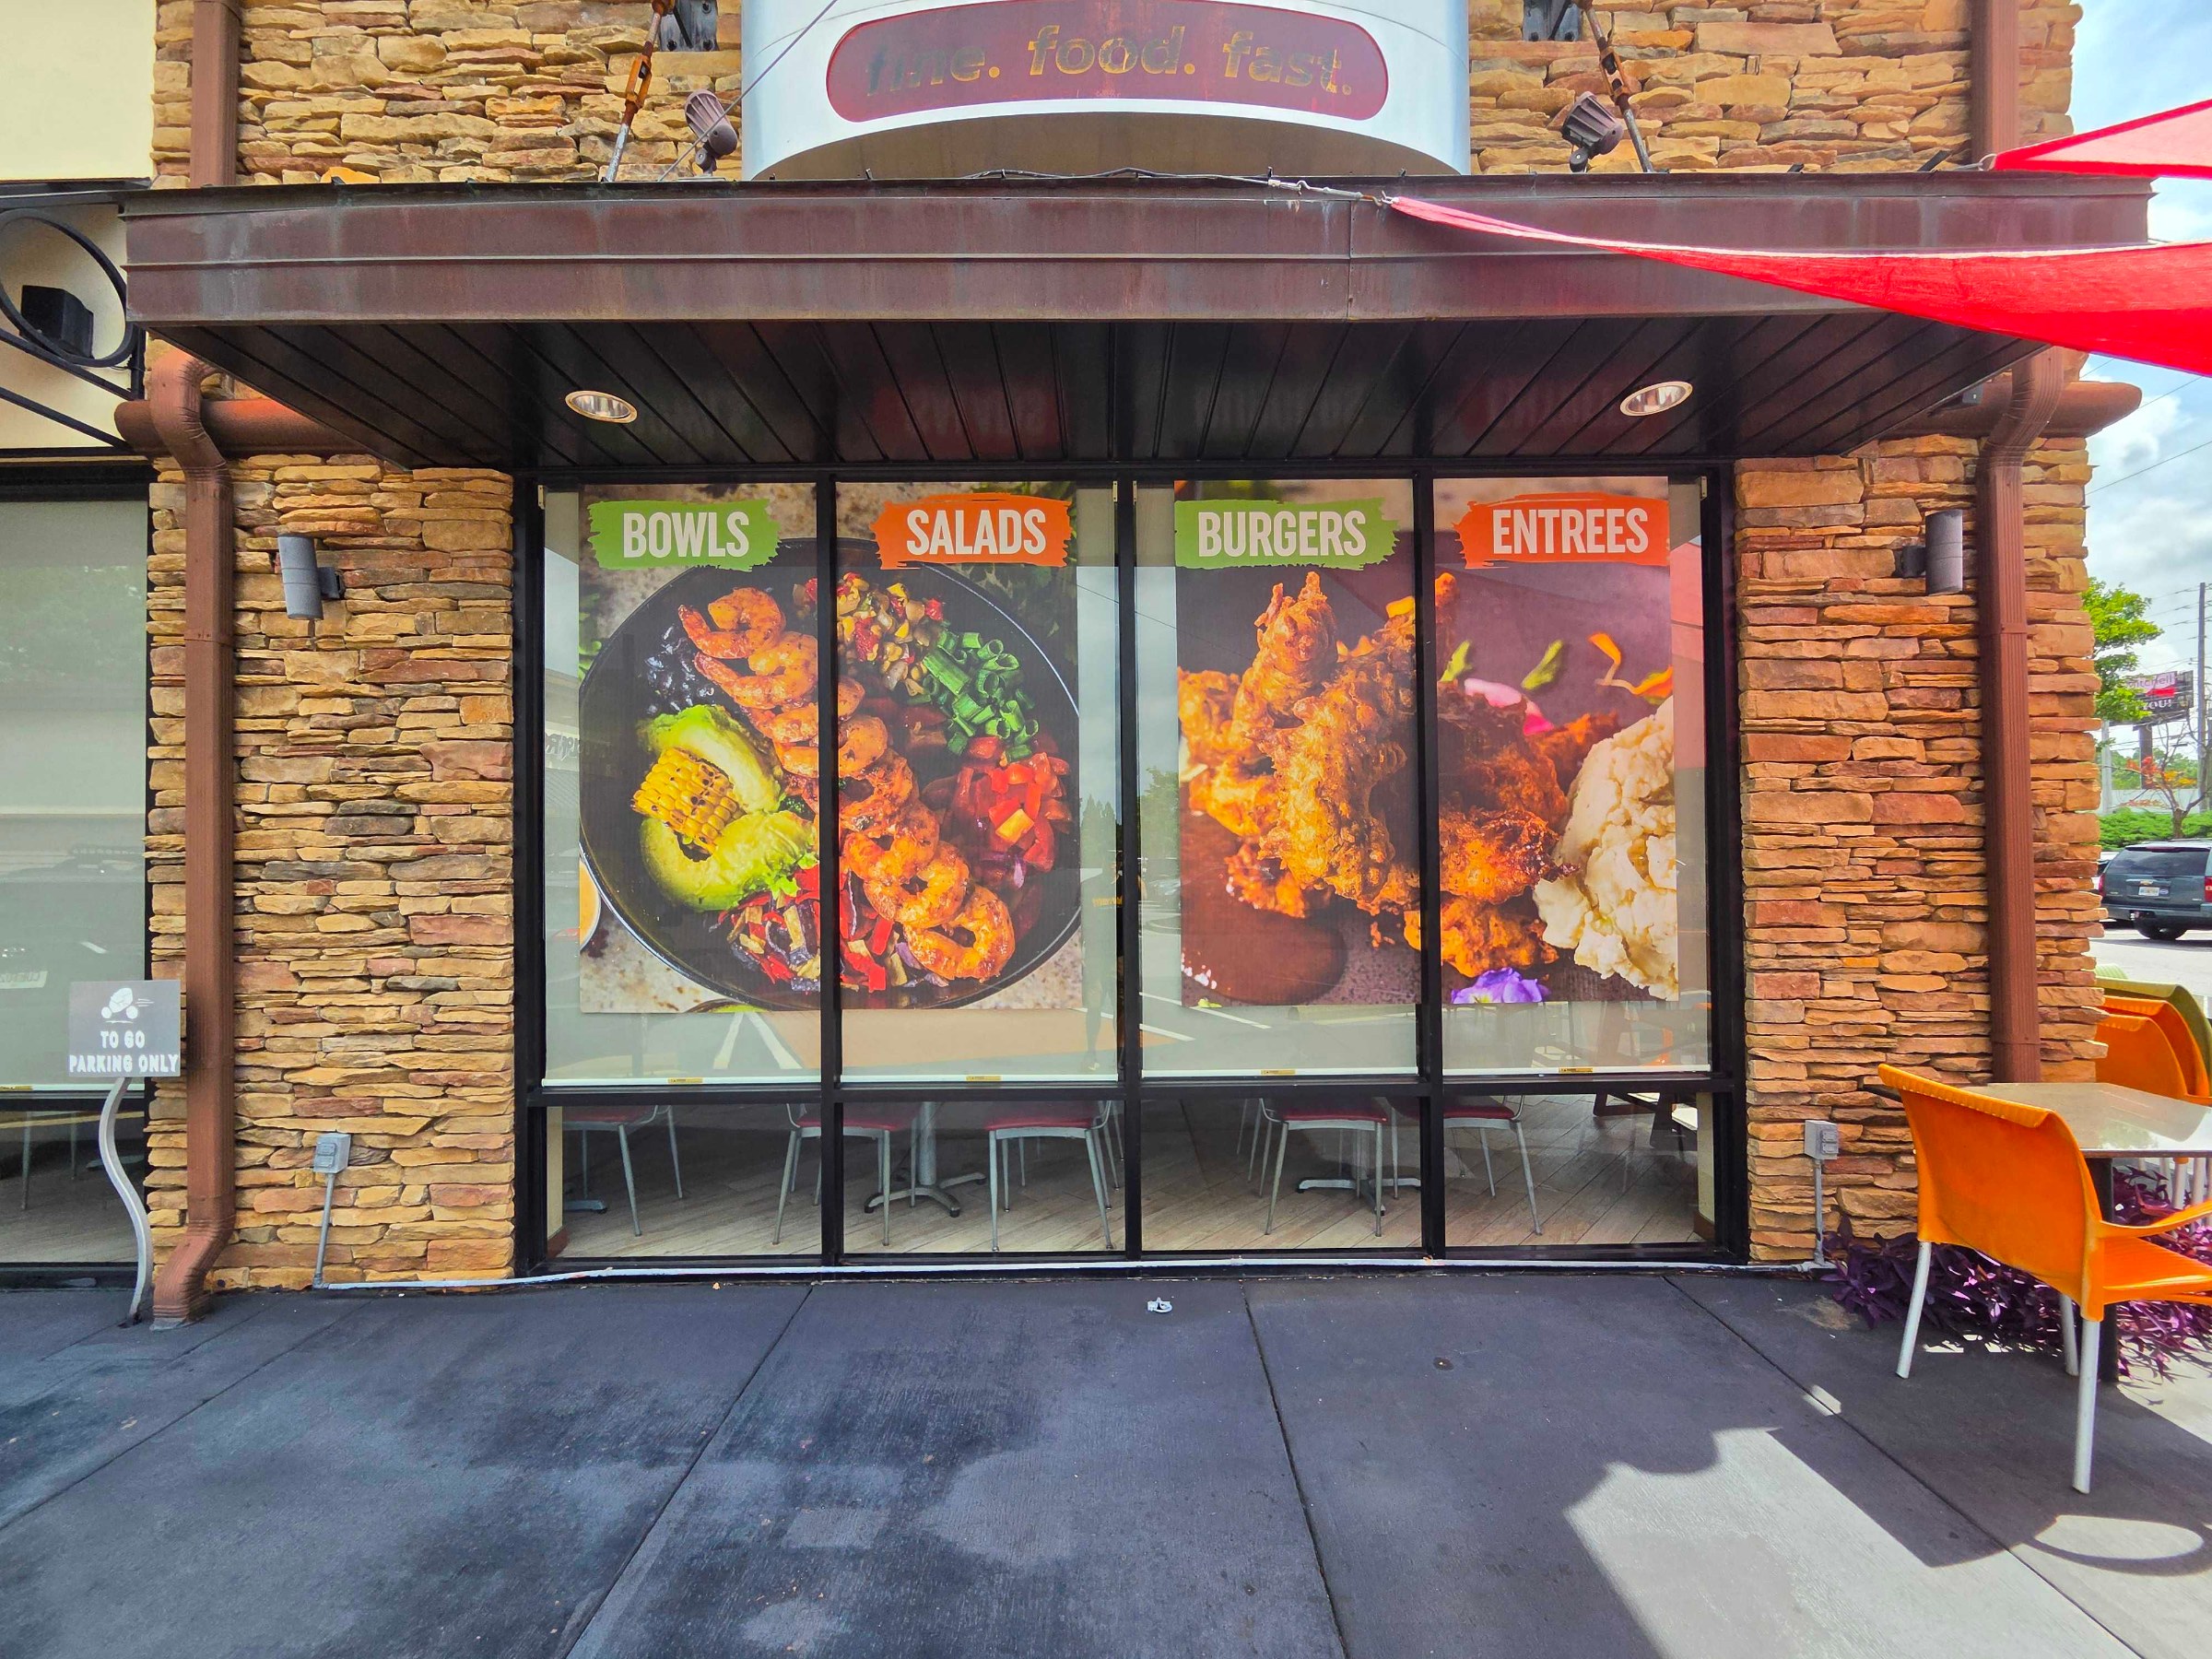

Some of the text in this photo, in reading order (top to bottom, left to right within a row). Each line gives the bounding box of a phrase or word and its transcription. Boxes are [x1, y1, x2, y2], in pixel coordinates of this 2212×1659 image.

[1028, 25, 1195, 75] food.
[1222, 30, 1352, 95] fast.
[623, 512, 749, 558] BOWLS
[906, 509, 1046, 555] SALADS
[1198, 510, 1367, 557] BURGERS
[1492, 508, 1648, 554] ENTREES
[100, 1030, 146, 1049] TO GO
[69, 1053, 178, 1073] PARKING ONLY
